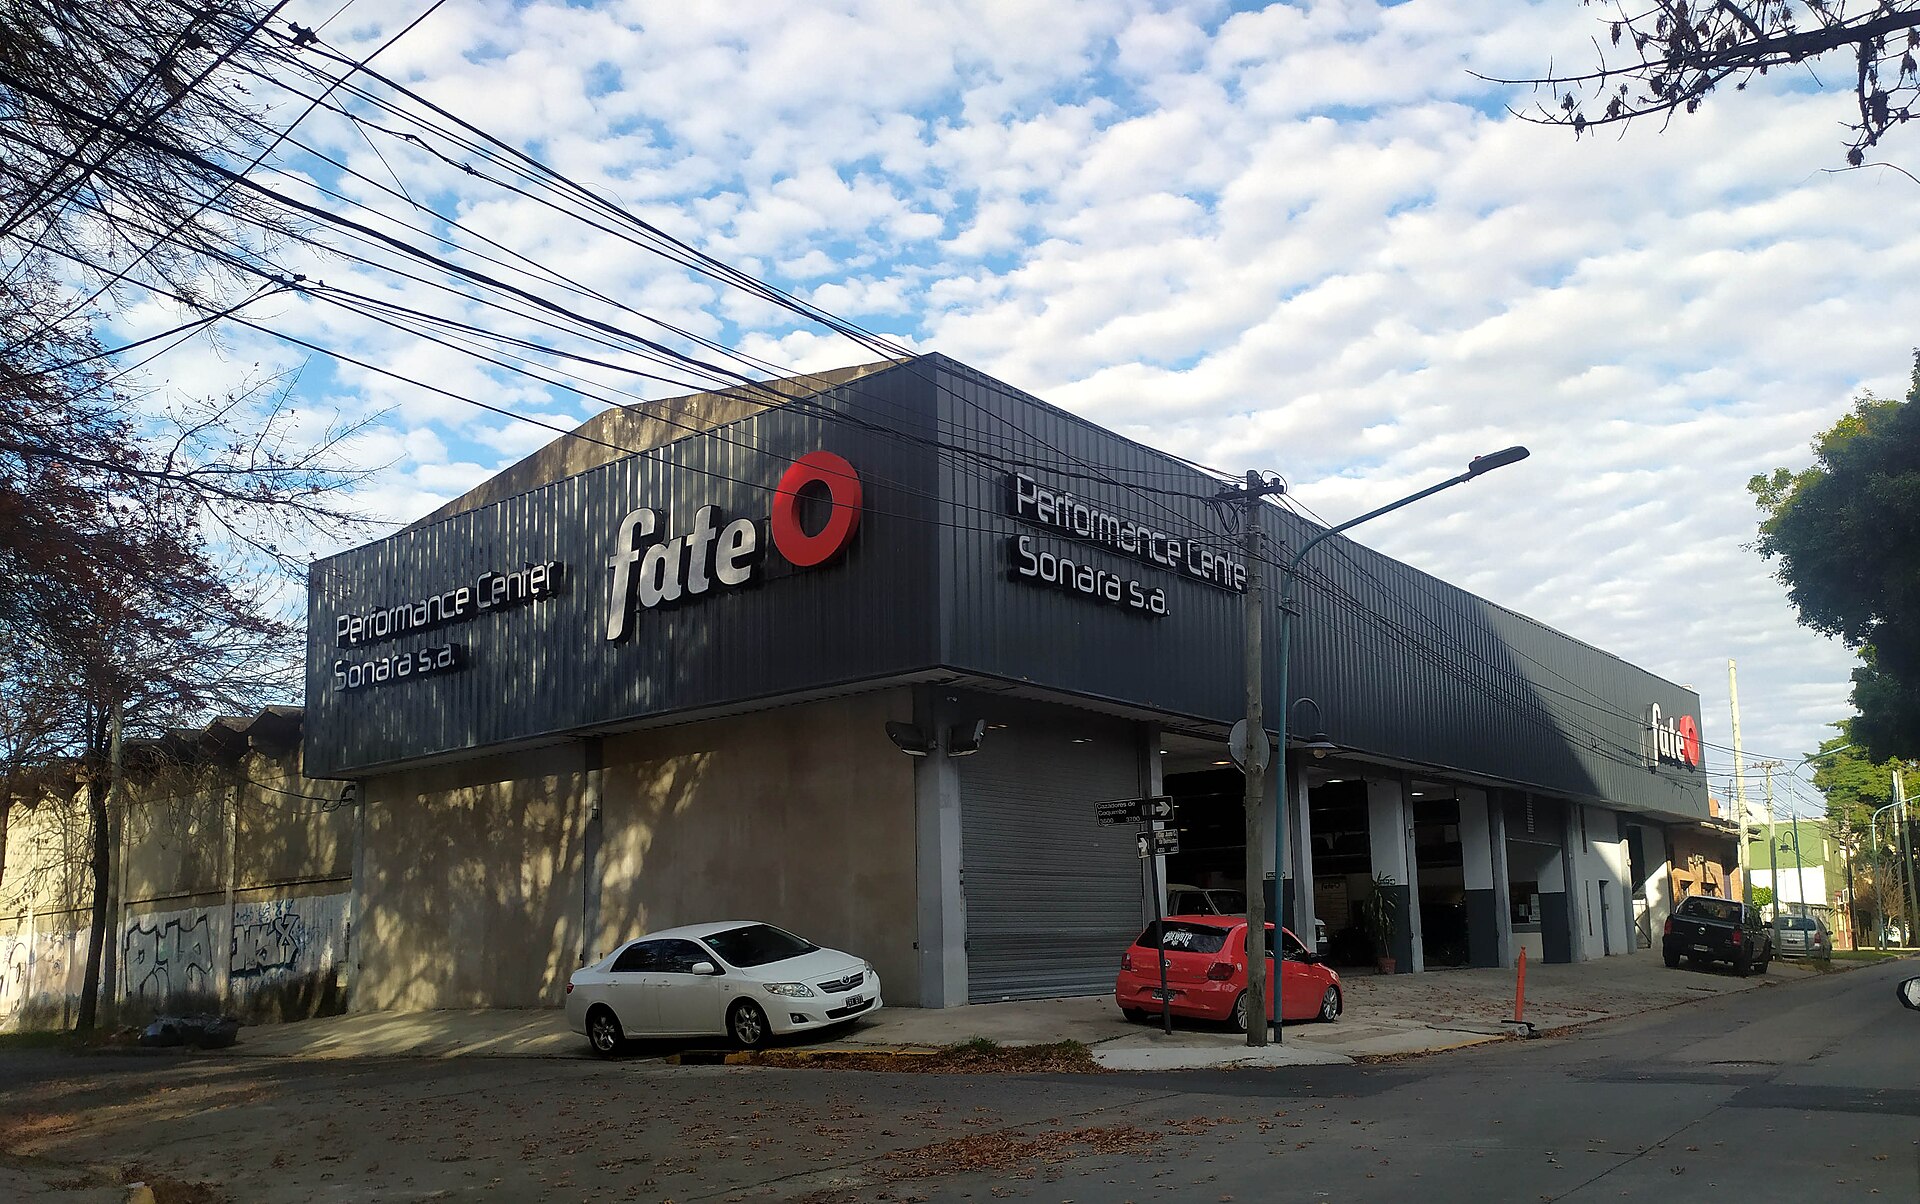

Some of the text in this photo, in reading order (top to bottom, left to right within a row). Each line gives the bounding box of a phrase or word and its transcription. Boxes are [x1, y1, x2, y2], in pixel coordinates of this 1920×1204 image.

[606, 504, 756, 641] fate
[1016, 472, 1248, 591] Performance Cente
[336, 561, 555, 648] Performance Center
[1018, 535, 1170, 616] Sonara s.a.
[334, 643, 455, 692] Sonara s.a.
[1651, 702, 1685, 767] fate
